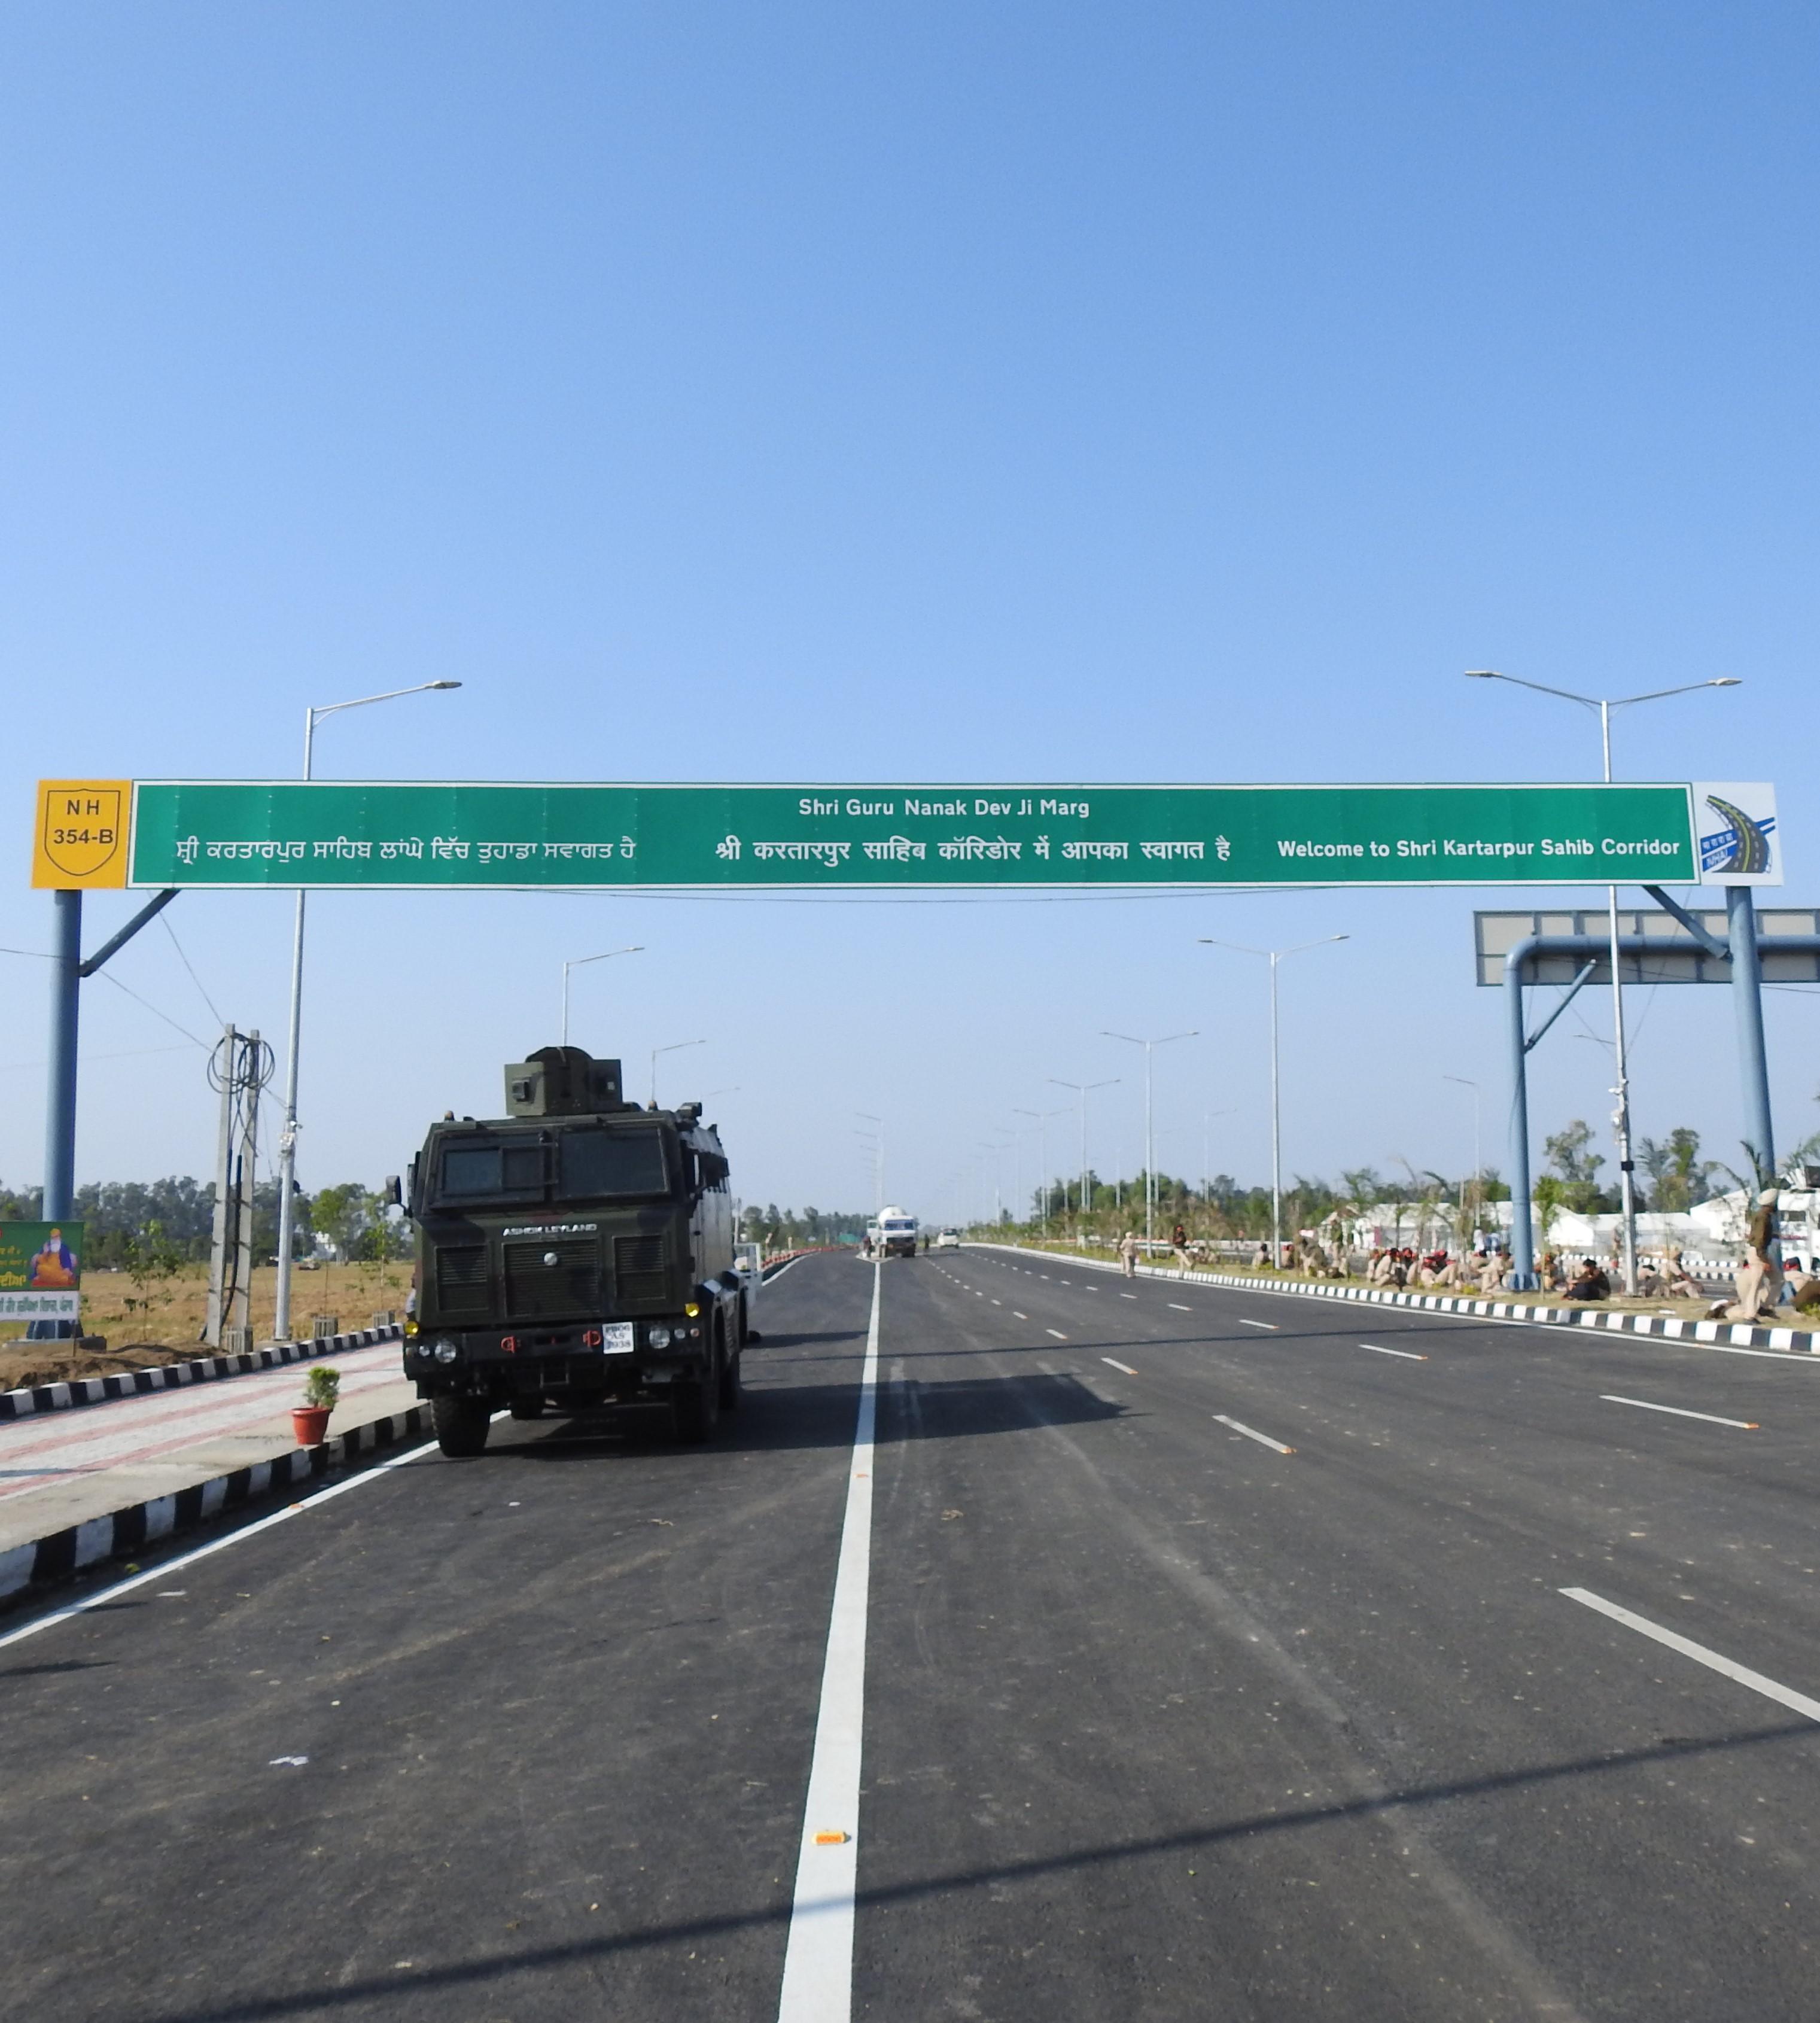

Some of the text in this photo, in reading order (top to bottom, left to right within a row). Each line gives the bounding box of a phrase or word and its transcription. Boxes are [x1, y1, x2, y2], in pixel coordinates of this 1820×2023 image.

[799, 798, 1089, 819] Shri Guru Nanak Dev Ji Marg
[53, 829, 113, 844] 354-B
[206, 841, 307, 863] ਕਰਤਾਰਪੁਰ
[312, 835, 373, 859] ਸਾਹਿਬ
[379, 836, 424, 859] ਲਾਂਘੇ
[430, 836, 471, 859] ਵਿੱਚ
[476, 842, 538, 863] ਤੁਹਾਡਾ
[543, 842, 614, 859] ਸਵਾਗਤ
[619, 835, 637, 859] ਹੈ
[715, 835, 1231, 868] श्री करतारपुर साहिब कॉरिडोर में आपका स्वागत है
[1277, 838, 1679, 858] Welcome to Shri Kartarpur Sahib Corridor
